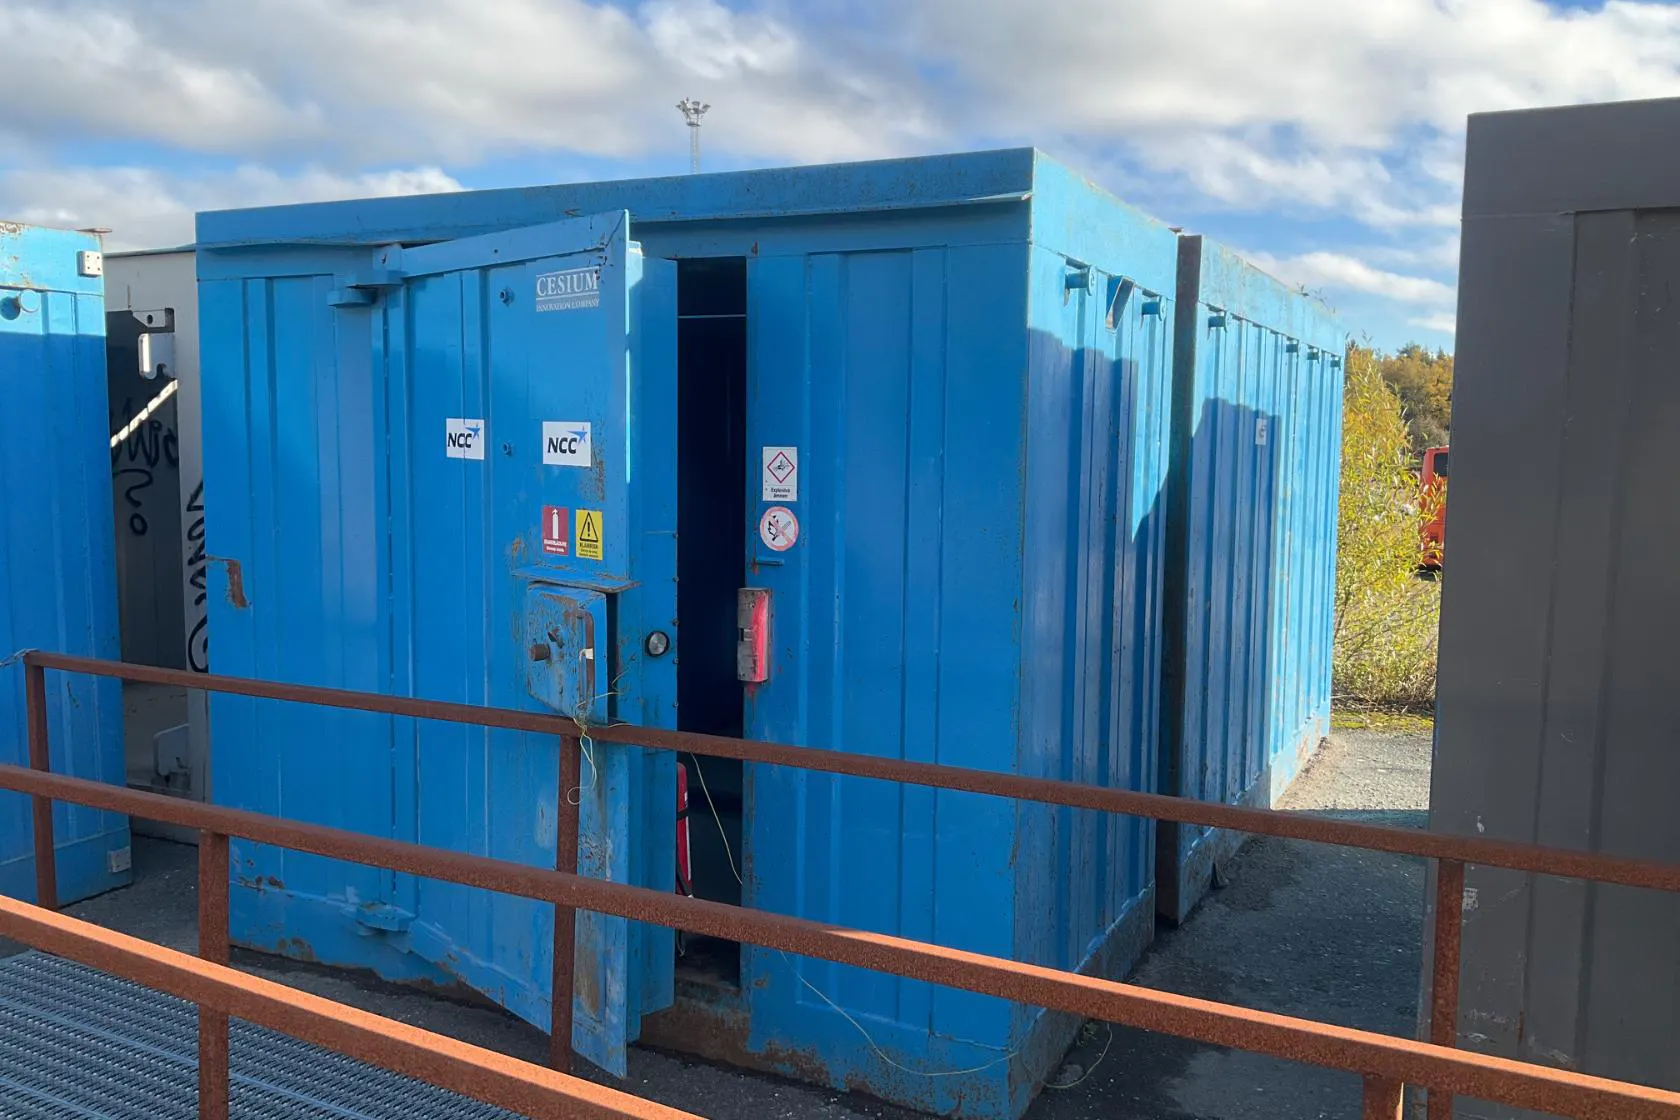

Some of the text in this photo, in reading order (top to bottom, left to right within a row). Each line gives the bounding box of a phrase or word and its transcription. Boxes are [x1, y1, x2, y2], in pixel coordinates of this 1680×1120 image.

[537, 272, 598, 296] CESIUM
[447, 432, 472, 448] NCC
[548, 437, 578, 454] NCC
